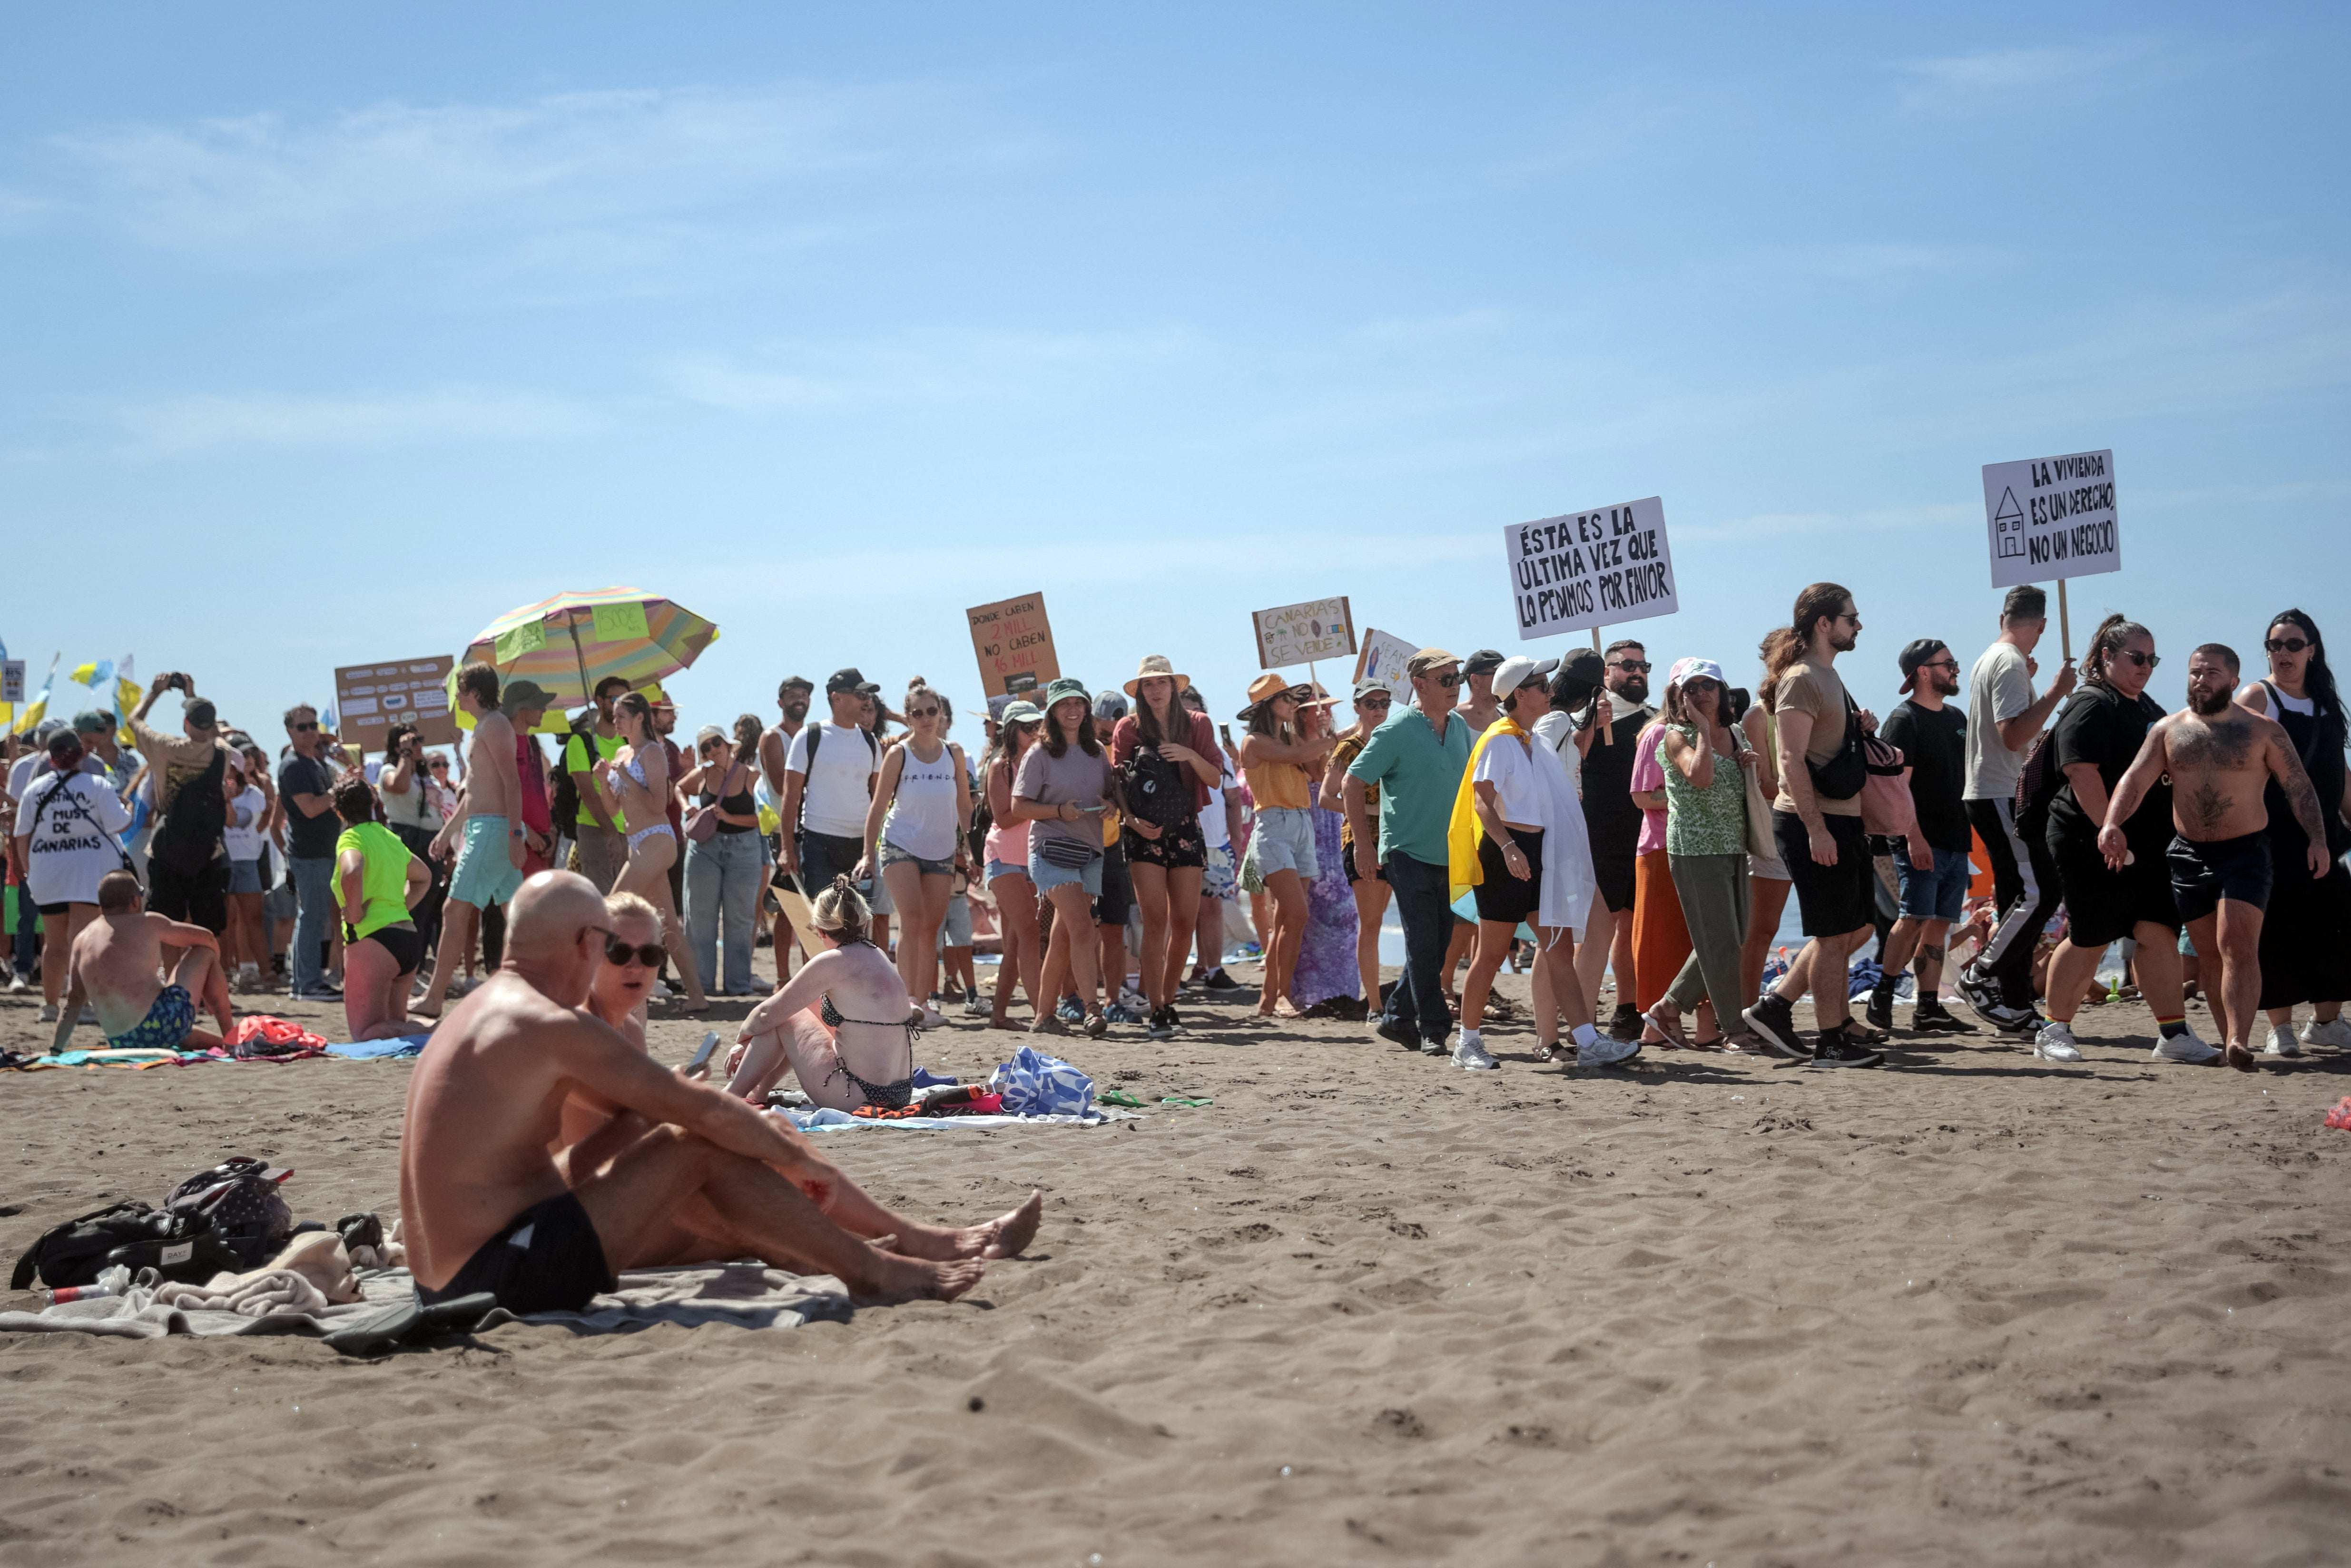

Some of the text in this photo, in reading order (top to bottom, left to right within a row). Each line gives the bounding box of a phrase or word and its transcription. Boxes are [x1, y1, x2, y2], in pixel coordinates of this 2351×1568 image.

[2031, 455, 2105, 488] LA VIVIENDA
[2030, 482, 2114, 526] ES UN DERECHO,
[1520, 506, 1636, 557] ÉSTA ES LA
[2029, 520, 2114, 565] NO UN NEGOCIO
[1517, 529, 1658, 590] ÚLTIMA VEZ QUE
[1518, 562, 1670, 627] LO PEDIMOS POR FAVOR
[972, 601, 1034, 625] DONDE CABEN
[991, 624, 1002, 639] 2
[1292, 622, 1308, 637] NO
[984, 630, 1045, 657] NO CABEN
[1271, 638, 1334, 665] SE VENDE
[995, 656, 1007, 674] 16
[53, 823, 70, 834] DE
